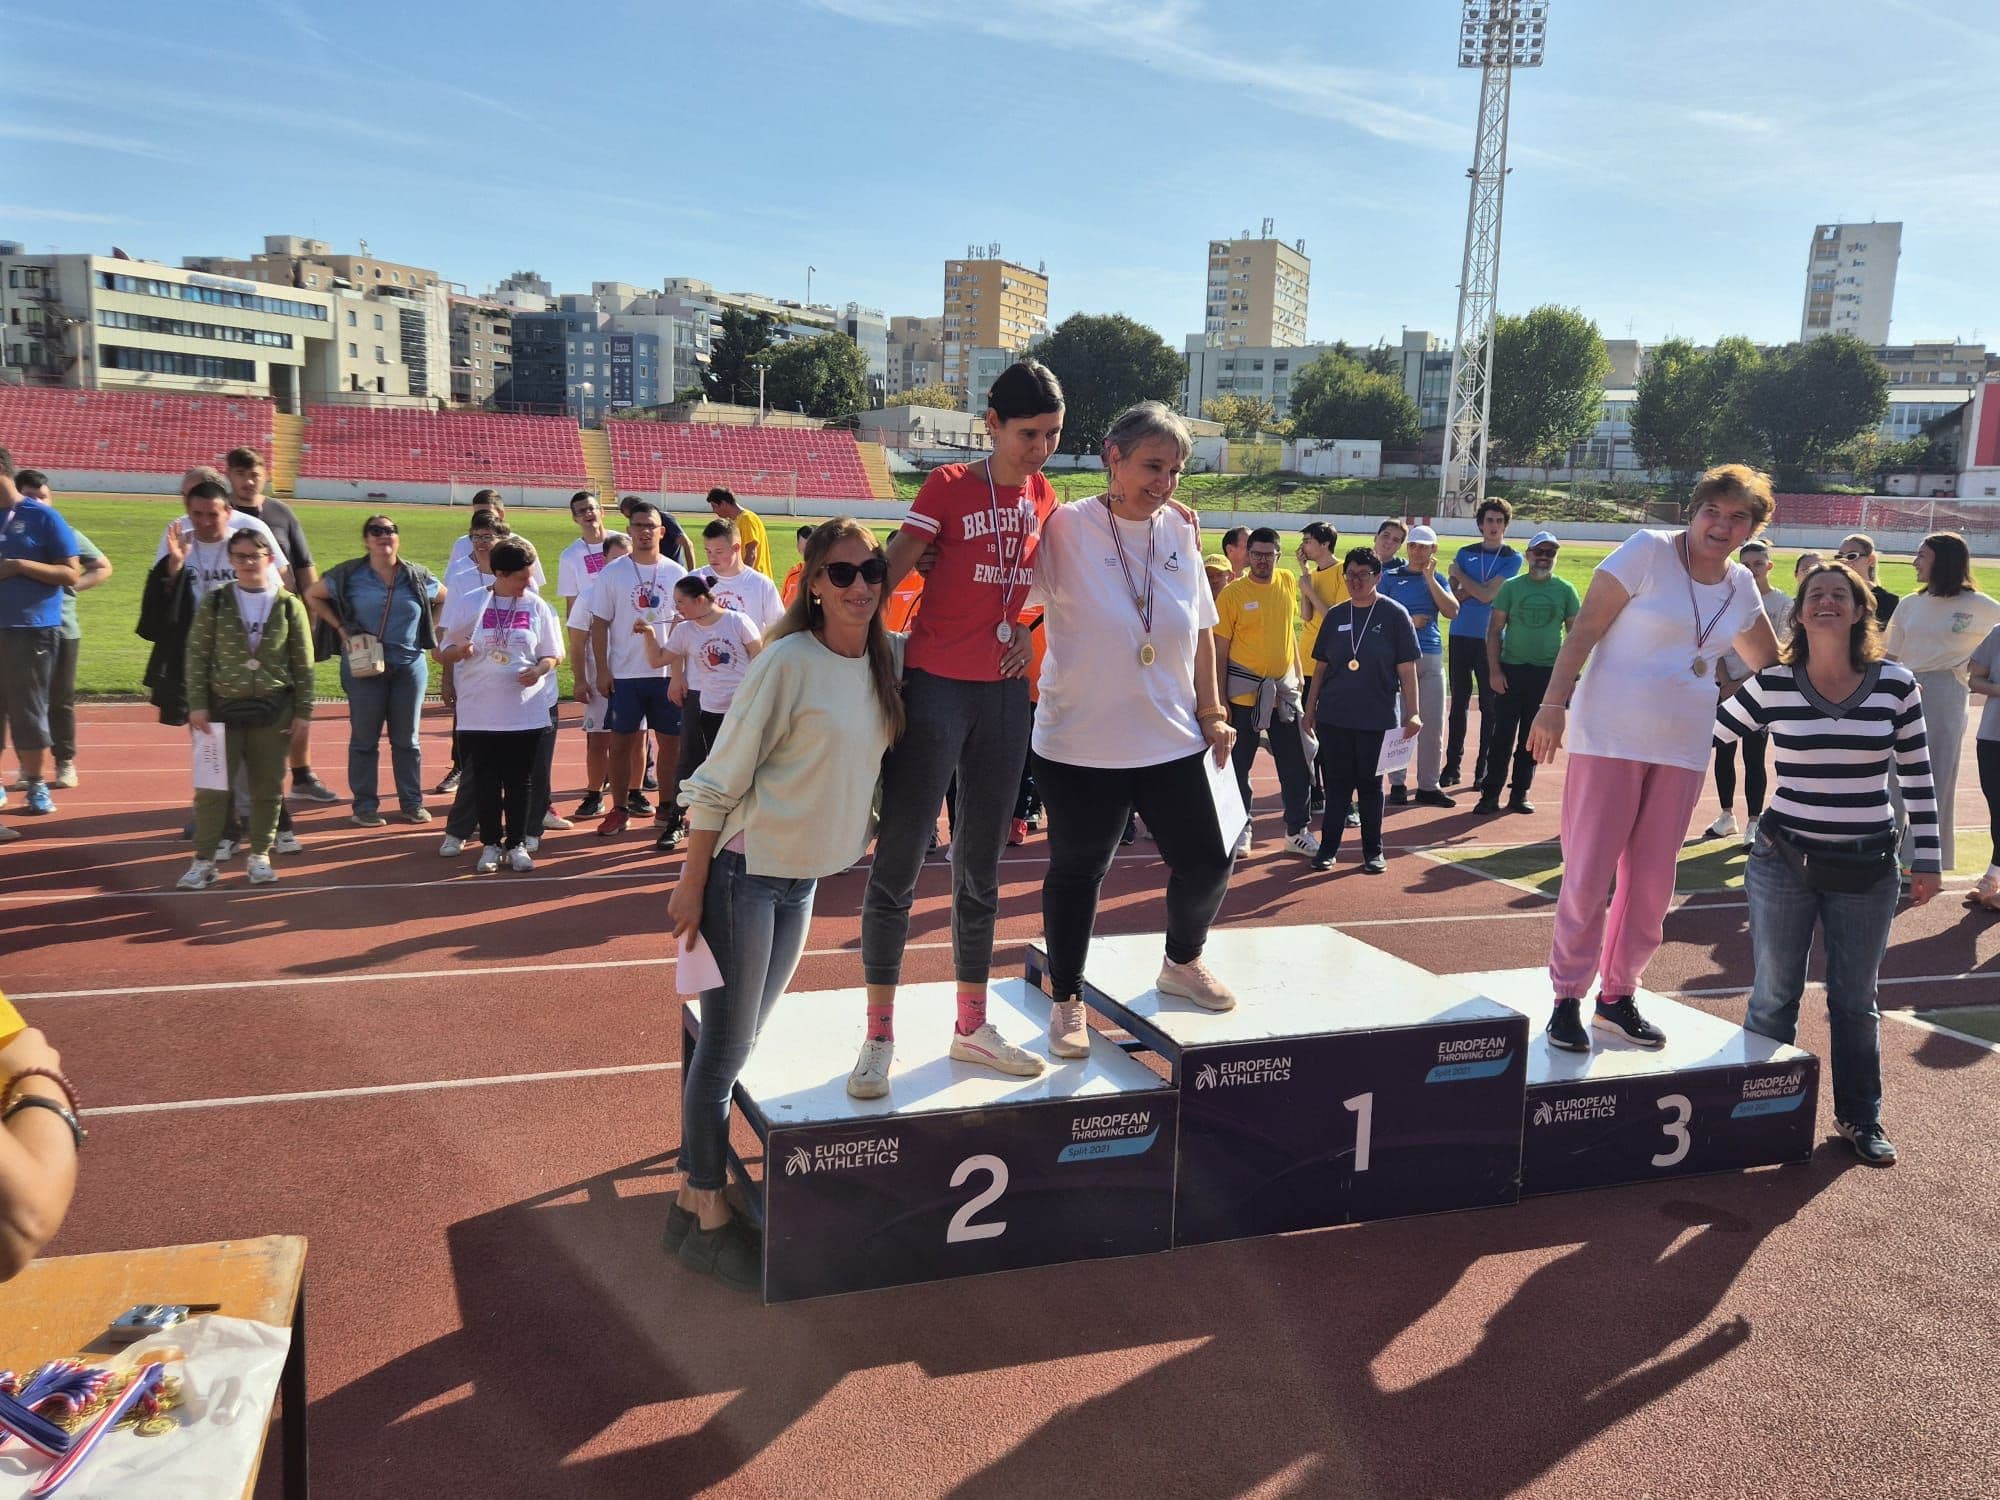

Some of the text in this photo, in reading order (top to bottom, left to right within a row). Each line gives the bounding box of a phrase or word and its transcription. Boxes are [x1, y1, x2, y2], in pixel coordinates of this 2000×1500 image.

[1005, 537, 1018, 558] U
[1438, 1036, 1506, 1055] EUROPEAN
[1437, 1048, 1505, 1063] THROWING CUP
[1220, 1056, 1292, 1074] EUROPEAN
[1219, 1069, 1291, 1087] ATHLETICS
[1742, 1074, 1801, 1092] EUROPEAN
[1742, 1085, 1799, 1099] THROWING CUP
[1555, 1094, 1617, 1112] EUROPEAN
[1071, 1111, 1150, 1132] EUROPEAN
[1554, 1105, 1616, 1123] ATHLETICS
[1071, 1124, 1148, 1142] THROWING CUP
[1342, 1091, 1374, 1172] 1
[1651, 1093, 1693, 1167] 3
[815, 1137, 899, 1158] EUROPEAN
[1067, 1144, 1110, 1158] Split 2021
[814, 1150, 899, 1172] ATHLETICS
[946, 1153, 1009, 1244] 2
